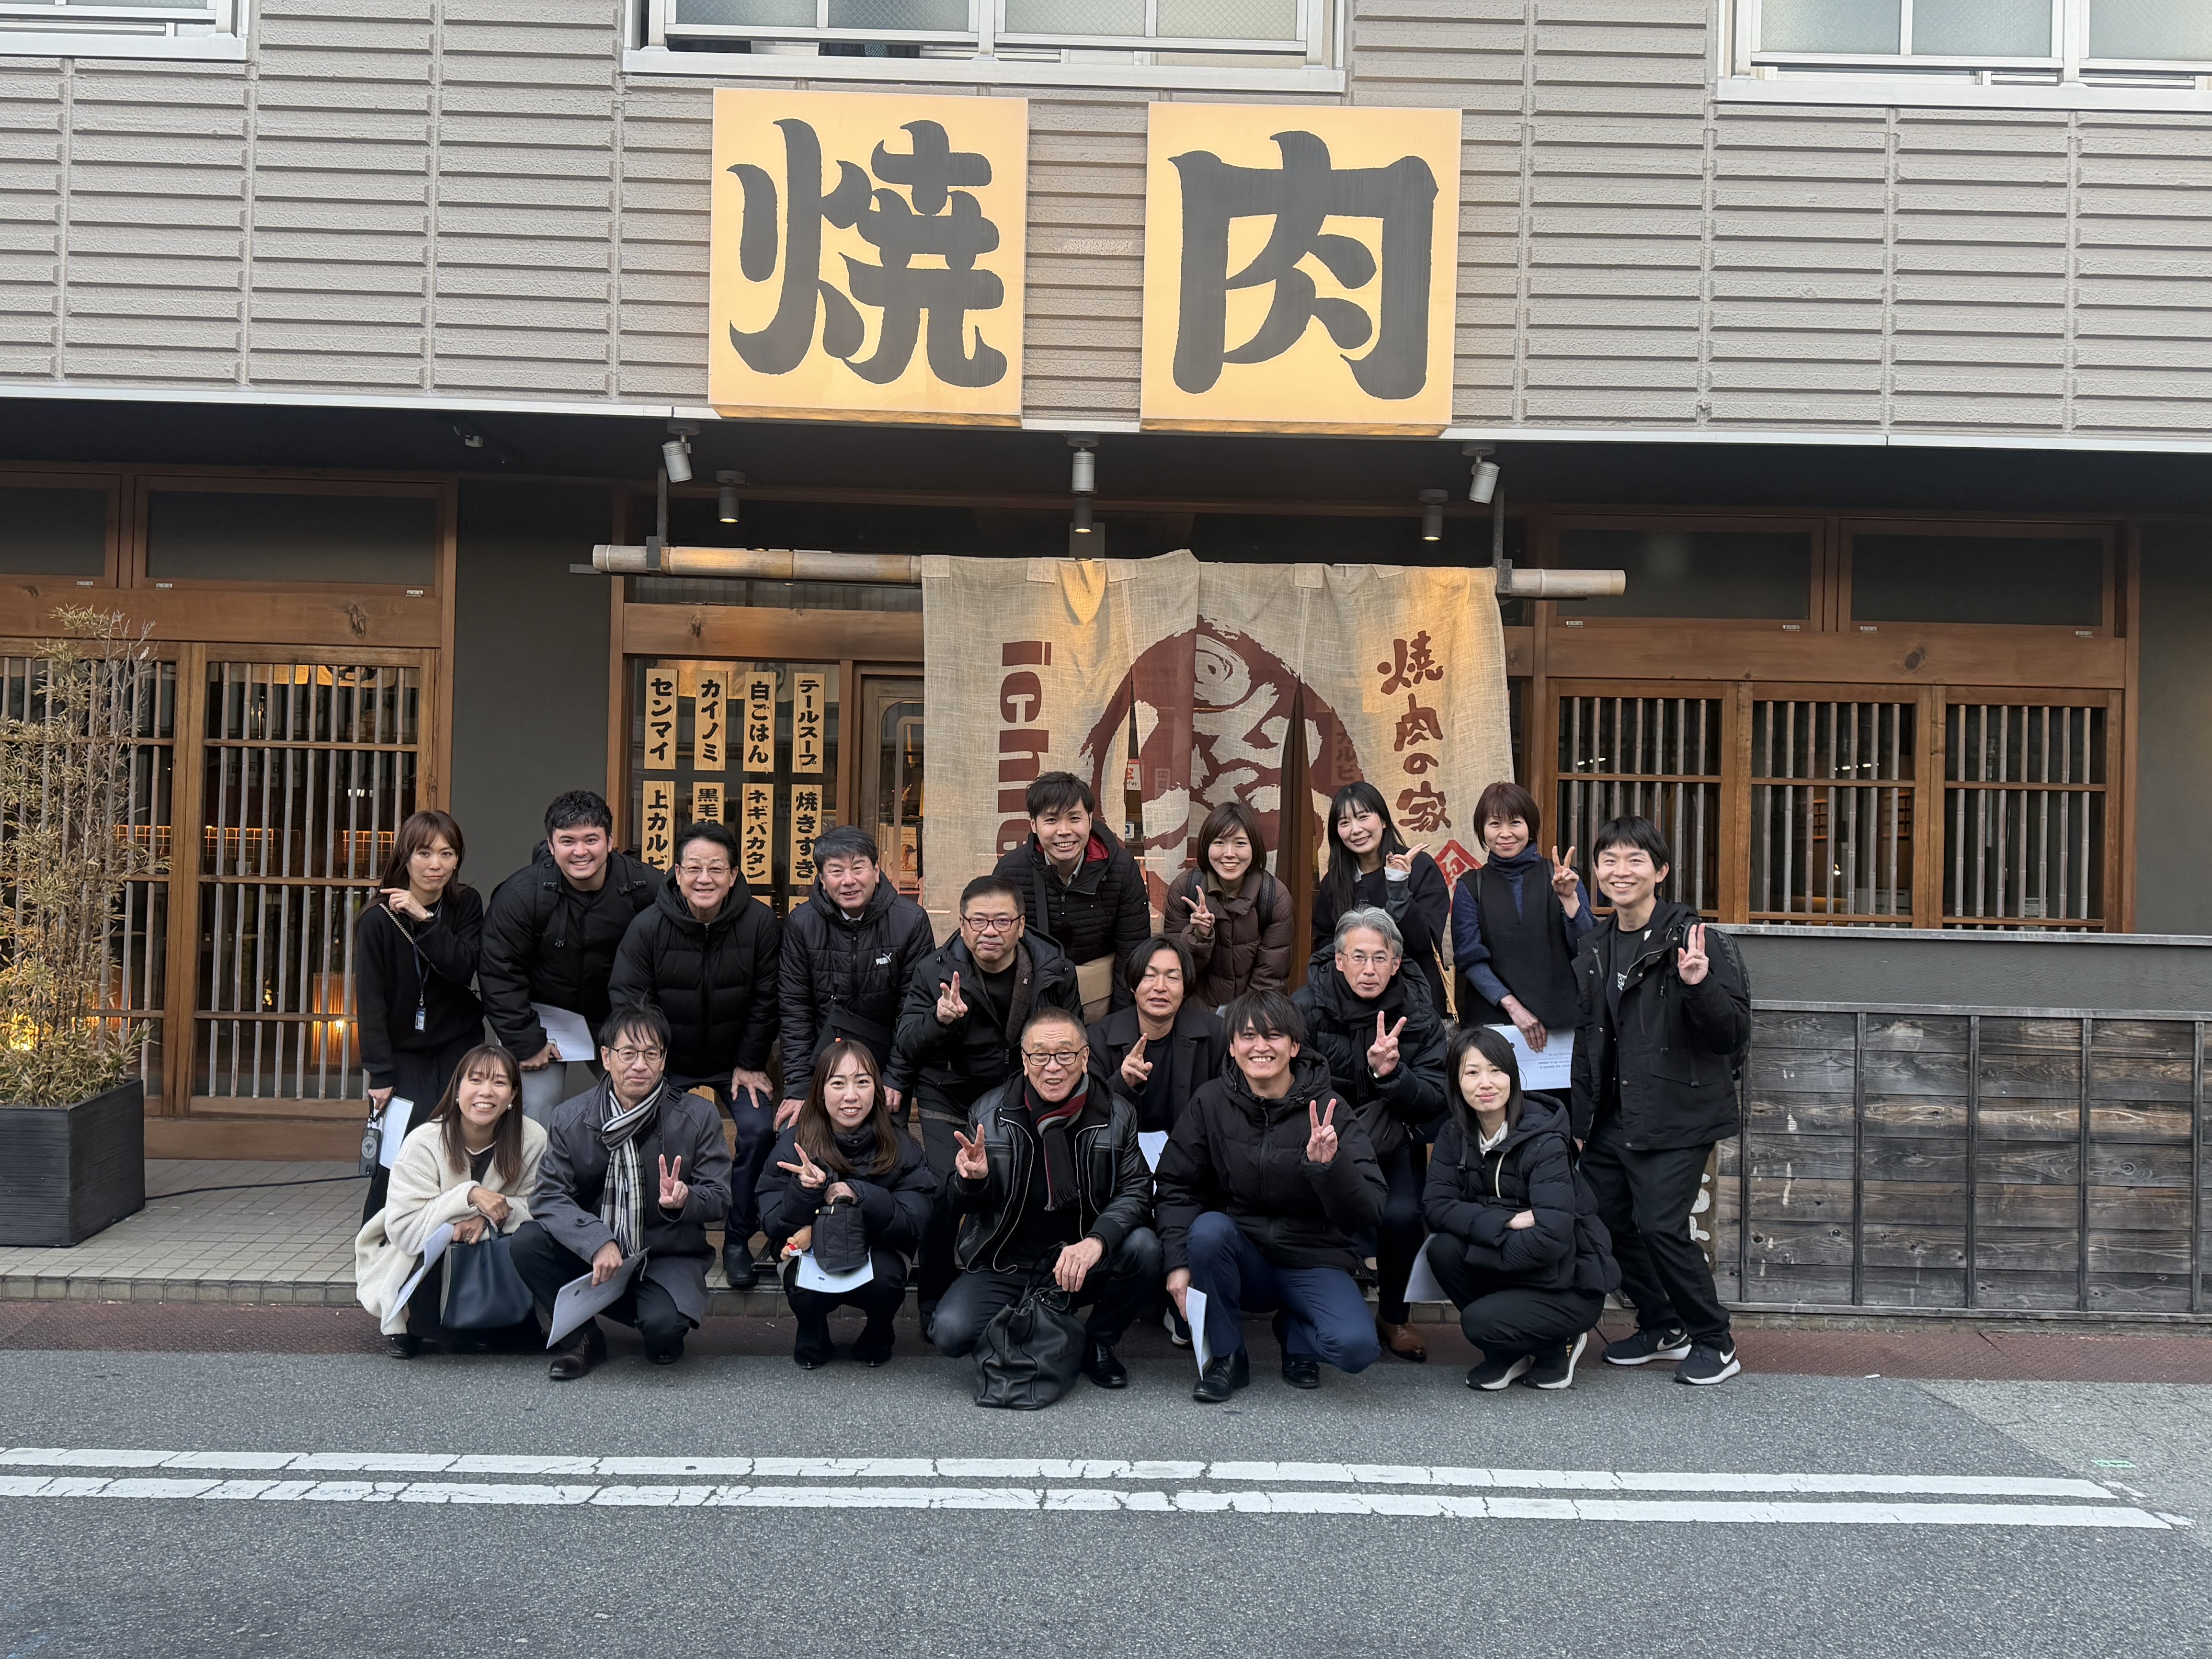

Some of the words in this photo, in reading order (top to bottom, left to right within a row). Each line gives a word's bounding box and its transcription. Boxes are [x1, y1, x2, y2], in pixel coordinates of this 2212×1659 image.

[726, 118, 1439, 400] 焼肉
[649, 678, 673, 761] センマイ
[700, 679, 721, 762] カイノミ
[748, 681, 770, 764] 白ごはん
[798, 680, 820, 766] テールスープ
[1377, 630, 1452, 833] 焼肉の家
[697, 788, 718, 823] 黒毛
[746, 790, 768, 878] ネギバカタン
[795, 791, 817, 878] 焼きすき
